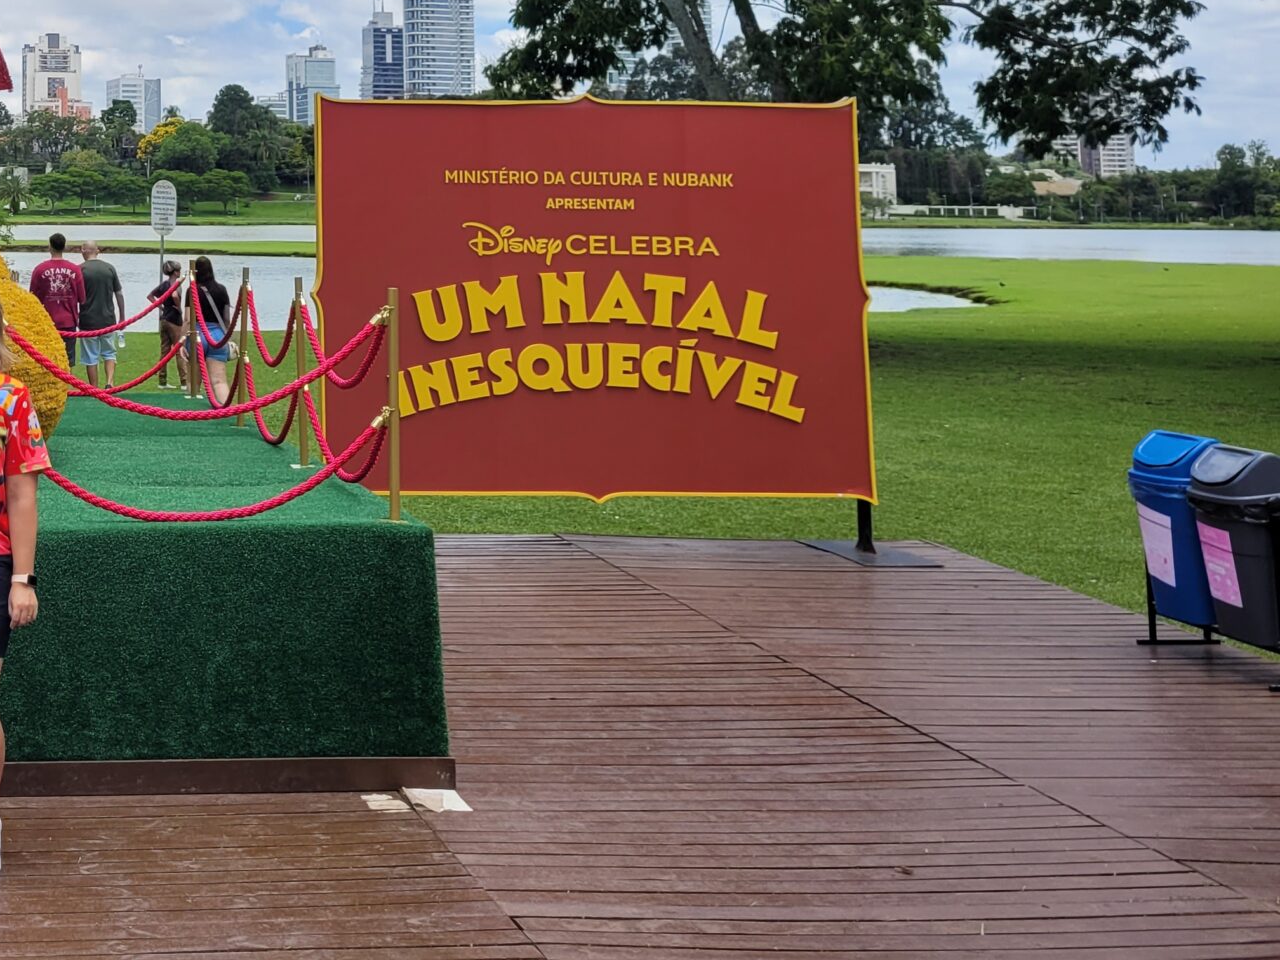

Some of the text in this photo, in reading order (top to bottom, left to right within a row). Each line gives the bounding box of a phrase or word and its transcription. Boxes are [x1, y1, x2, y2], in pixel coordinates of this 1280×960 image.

[444, 167, 733, 188] MINISTÉRIO DA CULTURA E NUBANK
[545, 197, 635, 210] APRESENTAM
[462, 221, 720, 265] Disney CELEBRA
[412, 270, 779, 350] UM NATAL
